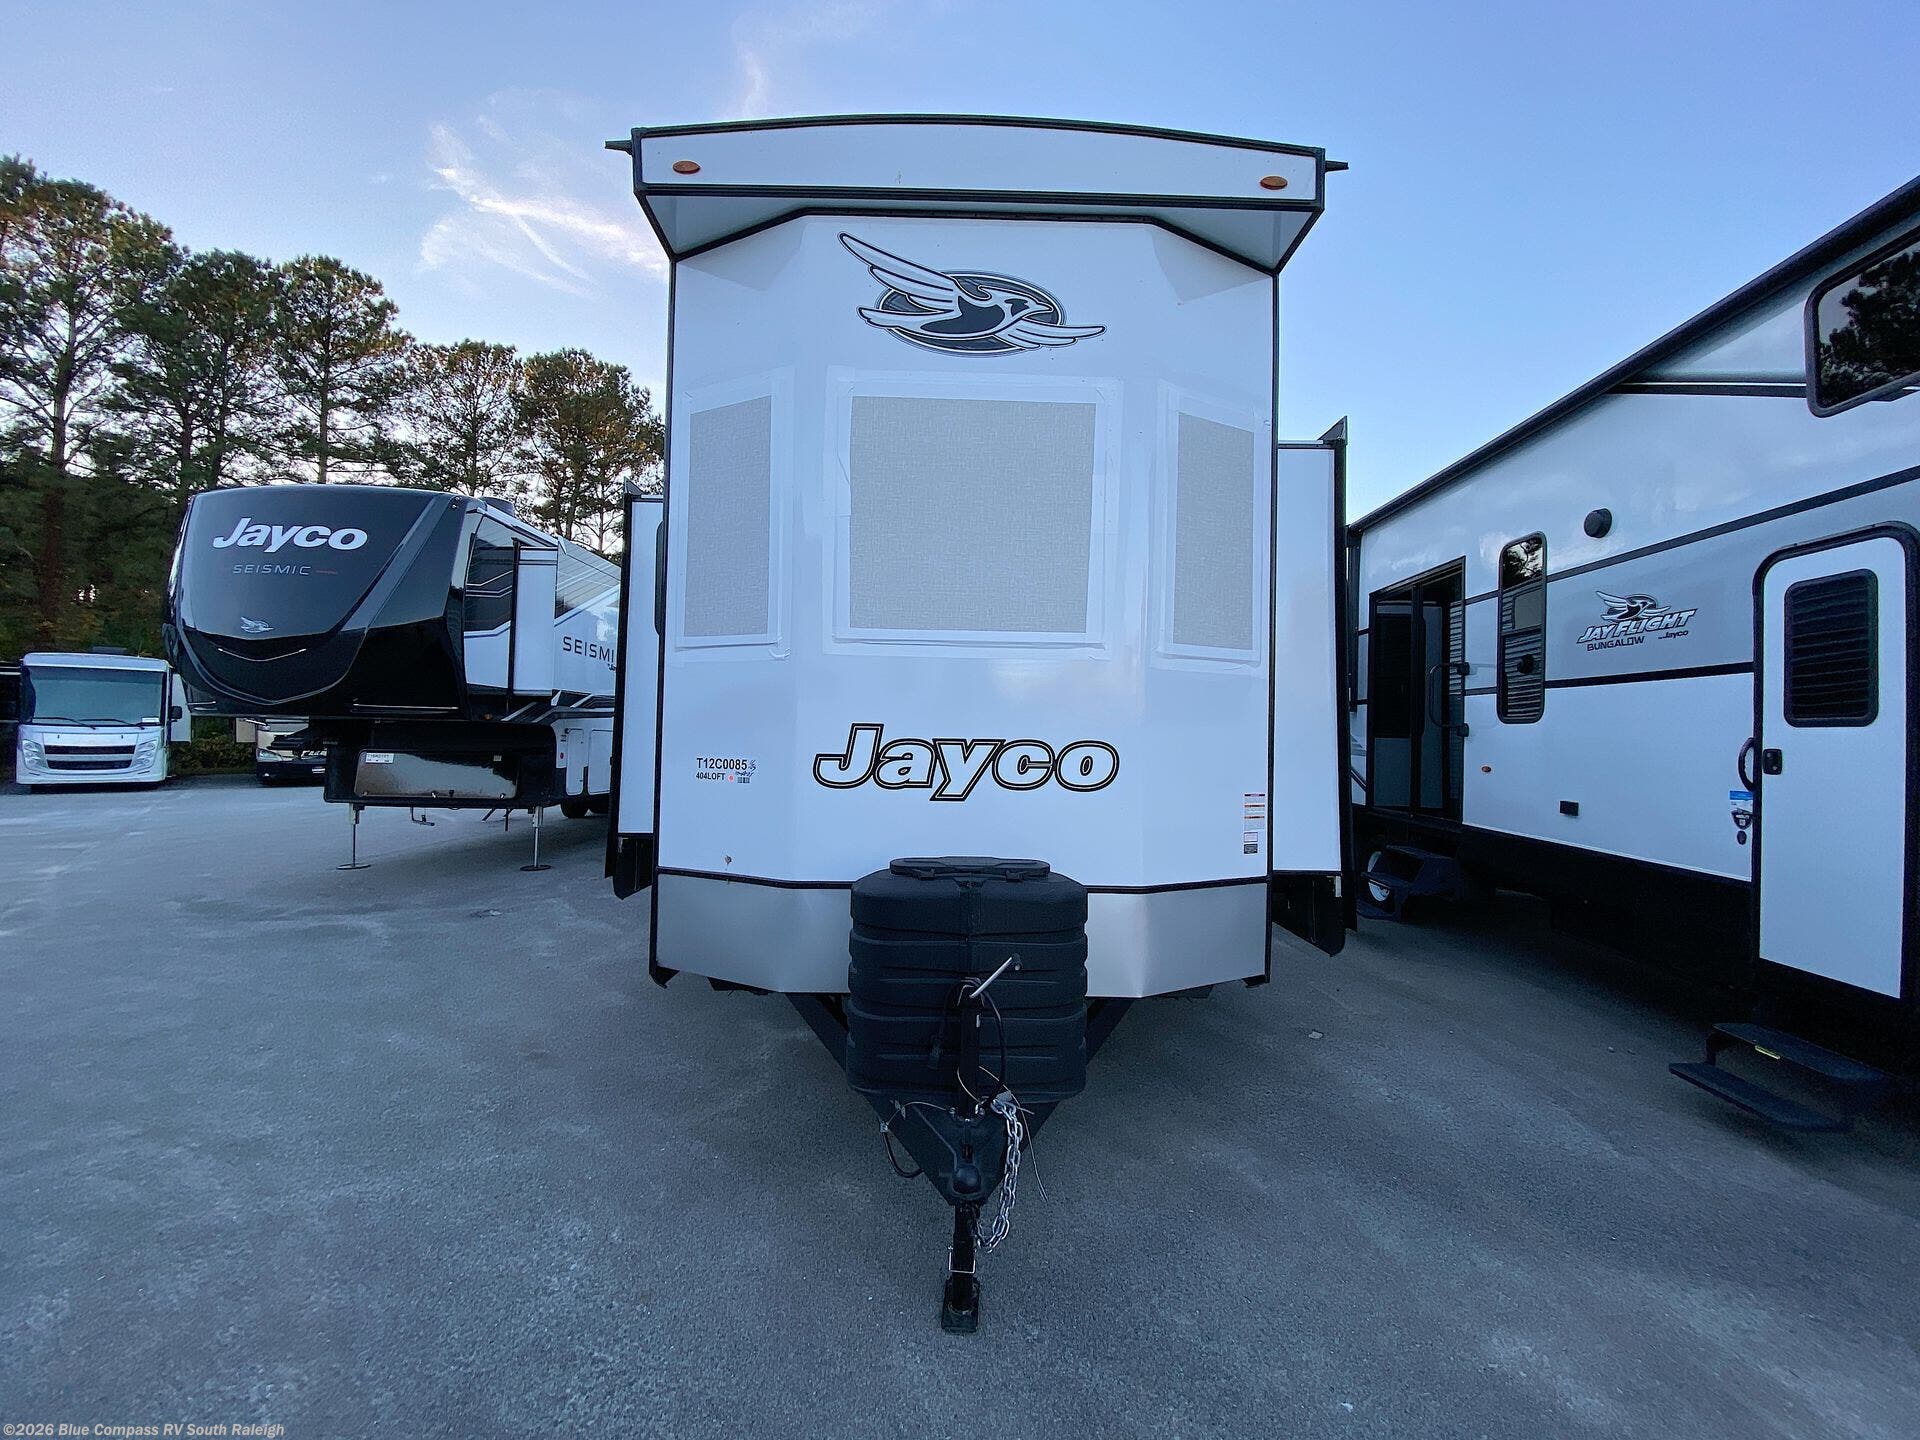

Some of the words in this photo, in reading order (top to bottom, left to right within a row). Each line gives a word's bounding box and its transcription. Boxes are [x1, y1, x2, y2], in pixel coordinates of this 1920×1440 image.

[213, 517, 368, 553] Jayco
[233, 564, 311, 575] SEISMIC
[1577, 624, 1616, 643] JAY
[1613, 608, 1698, 638] FLIGHT
[563, 636, 615, 663] SEISMI
[1587, 636, 1645, 652] BUNGALOW
[696, 757, 748, 770] T12C0085
[812, 722, 1120, 802] Jayco
[695, 771, 726, 781] 404LOFT
